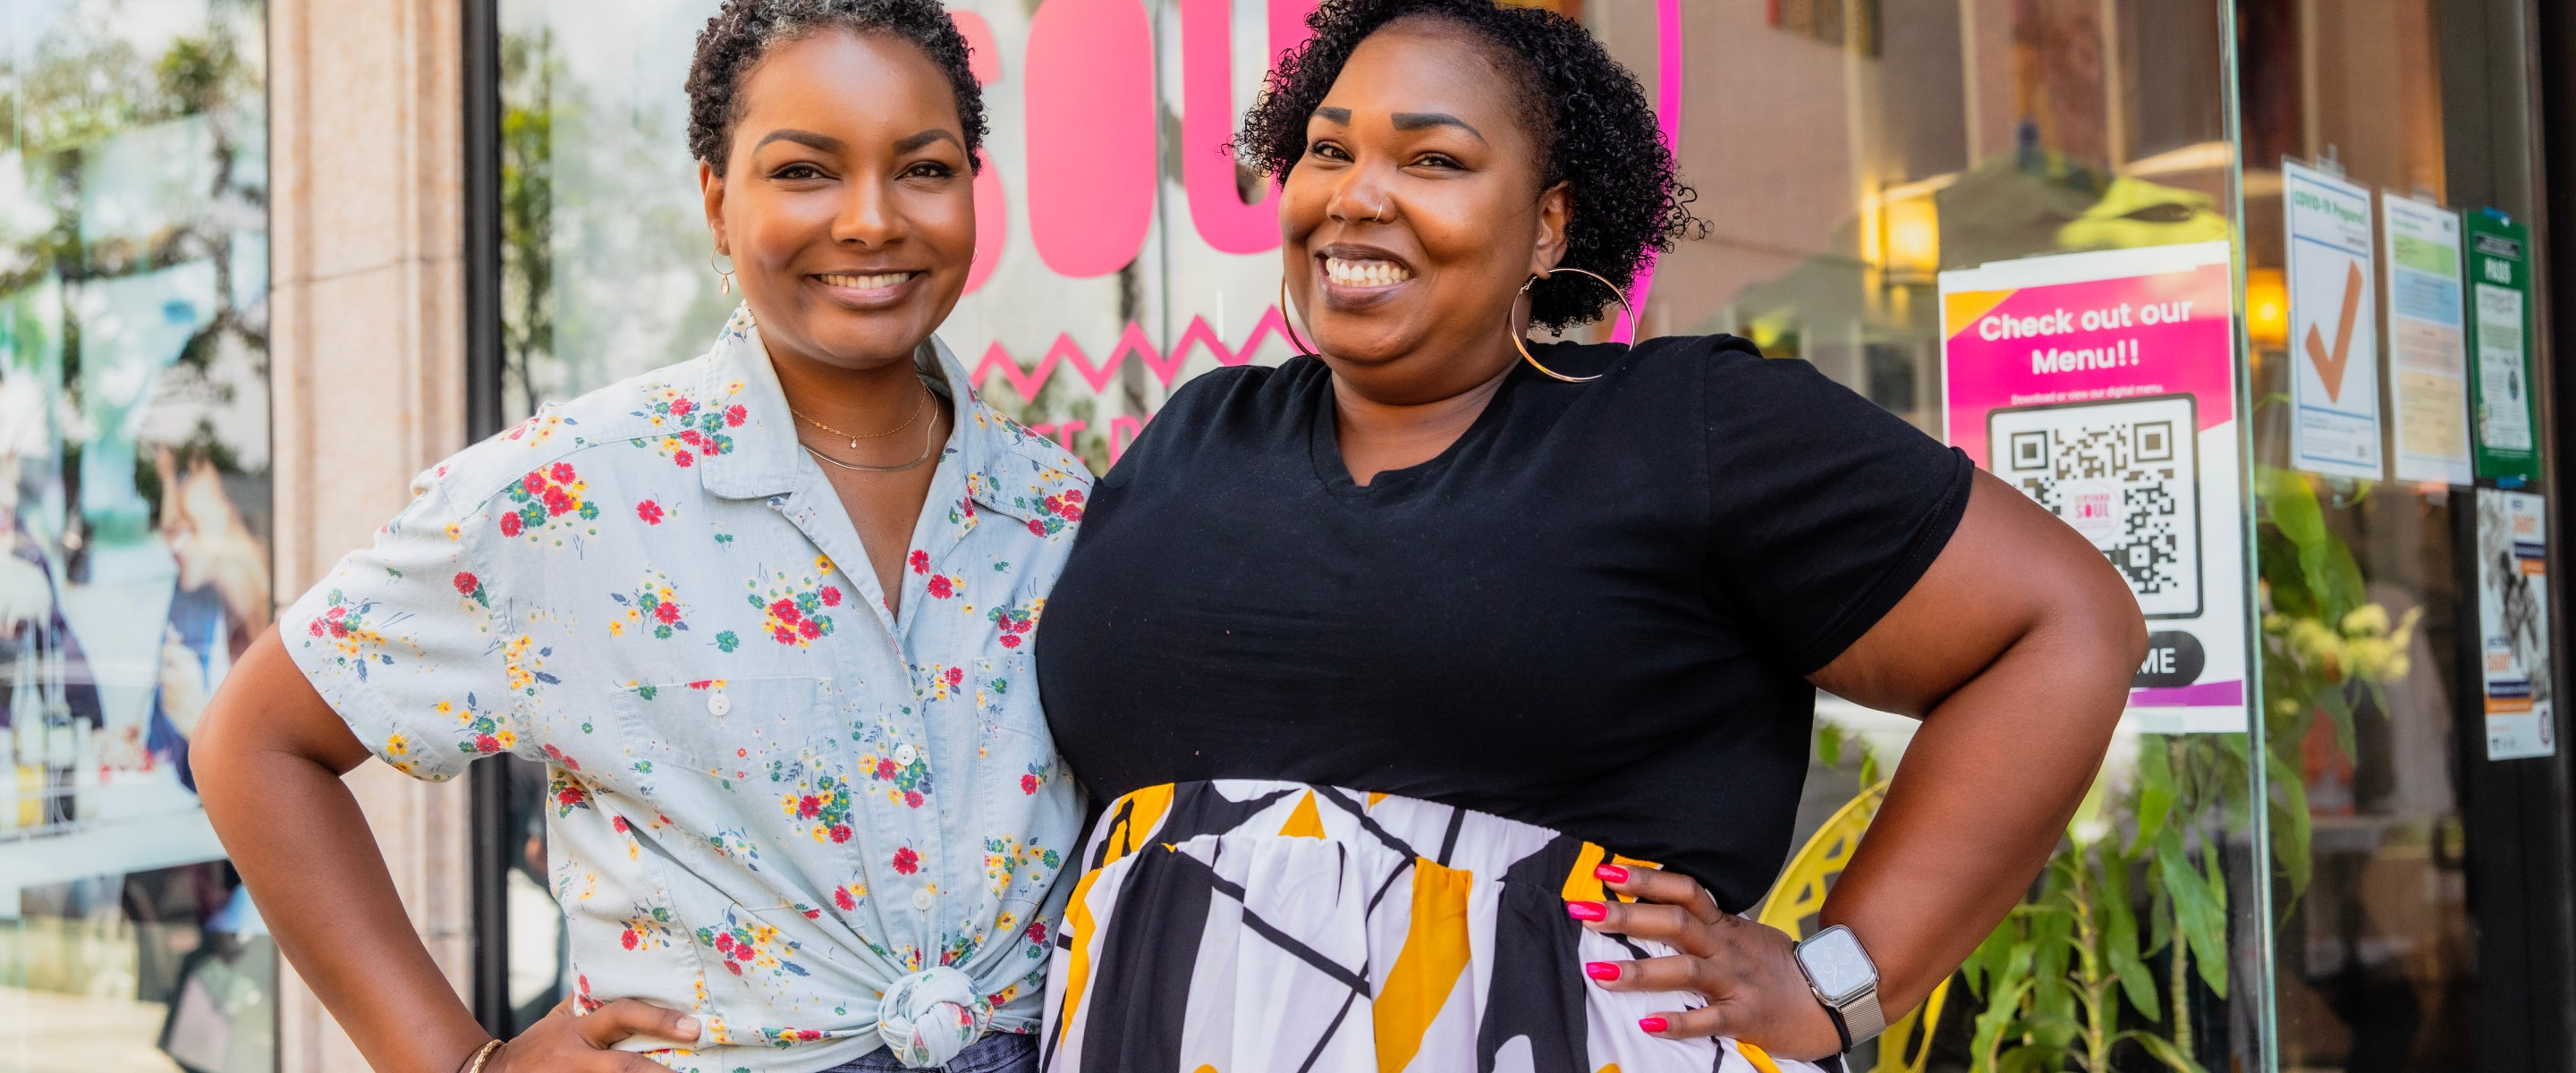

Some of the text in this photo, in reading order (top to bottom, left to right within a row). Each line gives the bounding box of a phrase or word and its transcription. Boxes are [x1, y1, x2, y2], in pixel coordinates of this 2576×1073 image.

[2484, 257, 2512, 284] PASS
[1979, 300, 2194, 342] Check out our
[2031, 338, 2140, 376] Menu!!
[2011, 391, 2055, 405] Download
[2057, 392, 2067, 401] or
[2068, 388, 2089, 400] view
[2089, 388, 2105, 398] our
[2106, 384, 2134, 398] digital
[2075, 503, 2110, 520] SOUL
